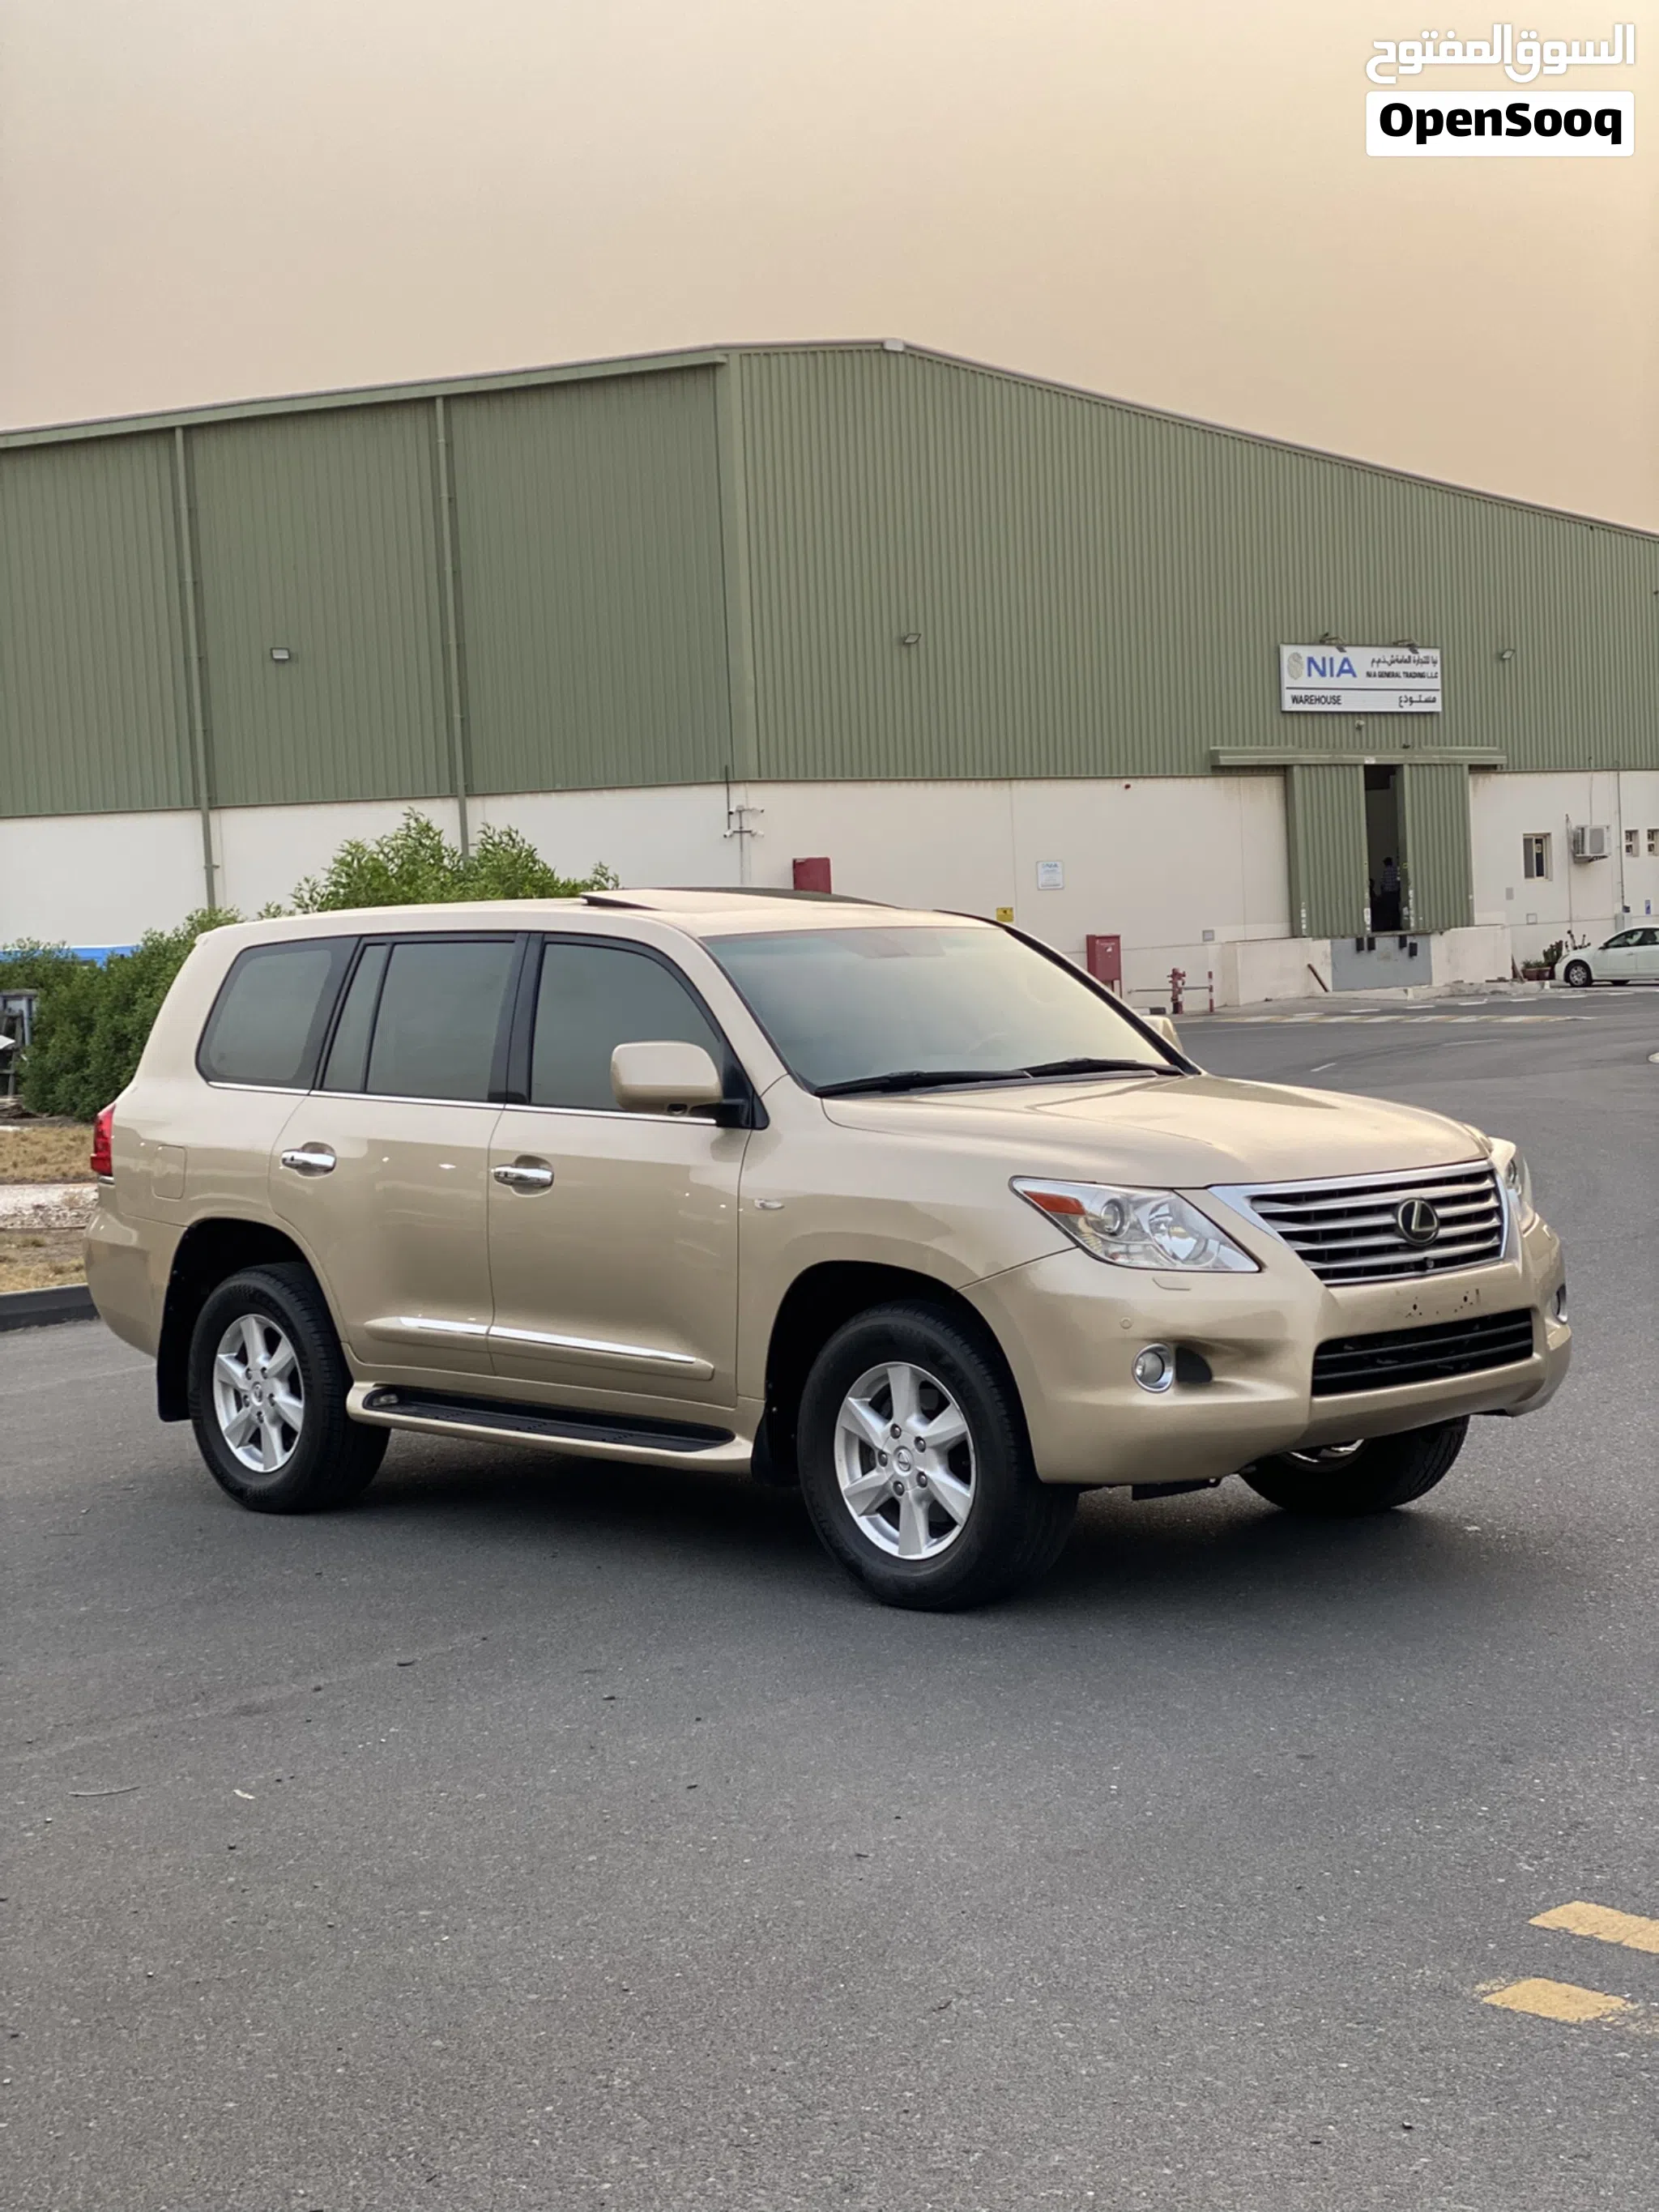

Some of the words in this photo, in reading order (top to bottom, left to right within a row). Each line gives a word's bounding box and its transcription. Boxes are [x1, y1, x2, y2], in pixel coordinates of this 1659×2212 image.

[1307, 656, 1357, 678] NIA
[1402, 671, 1426, 679] TRADING
[1290, 694, 1341, 705] WAREHOUSE
[1398, 694, 1436, 708] مستودع
